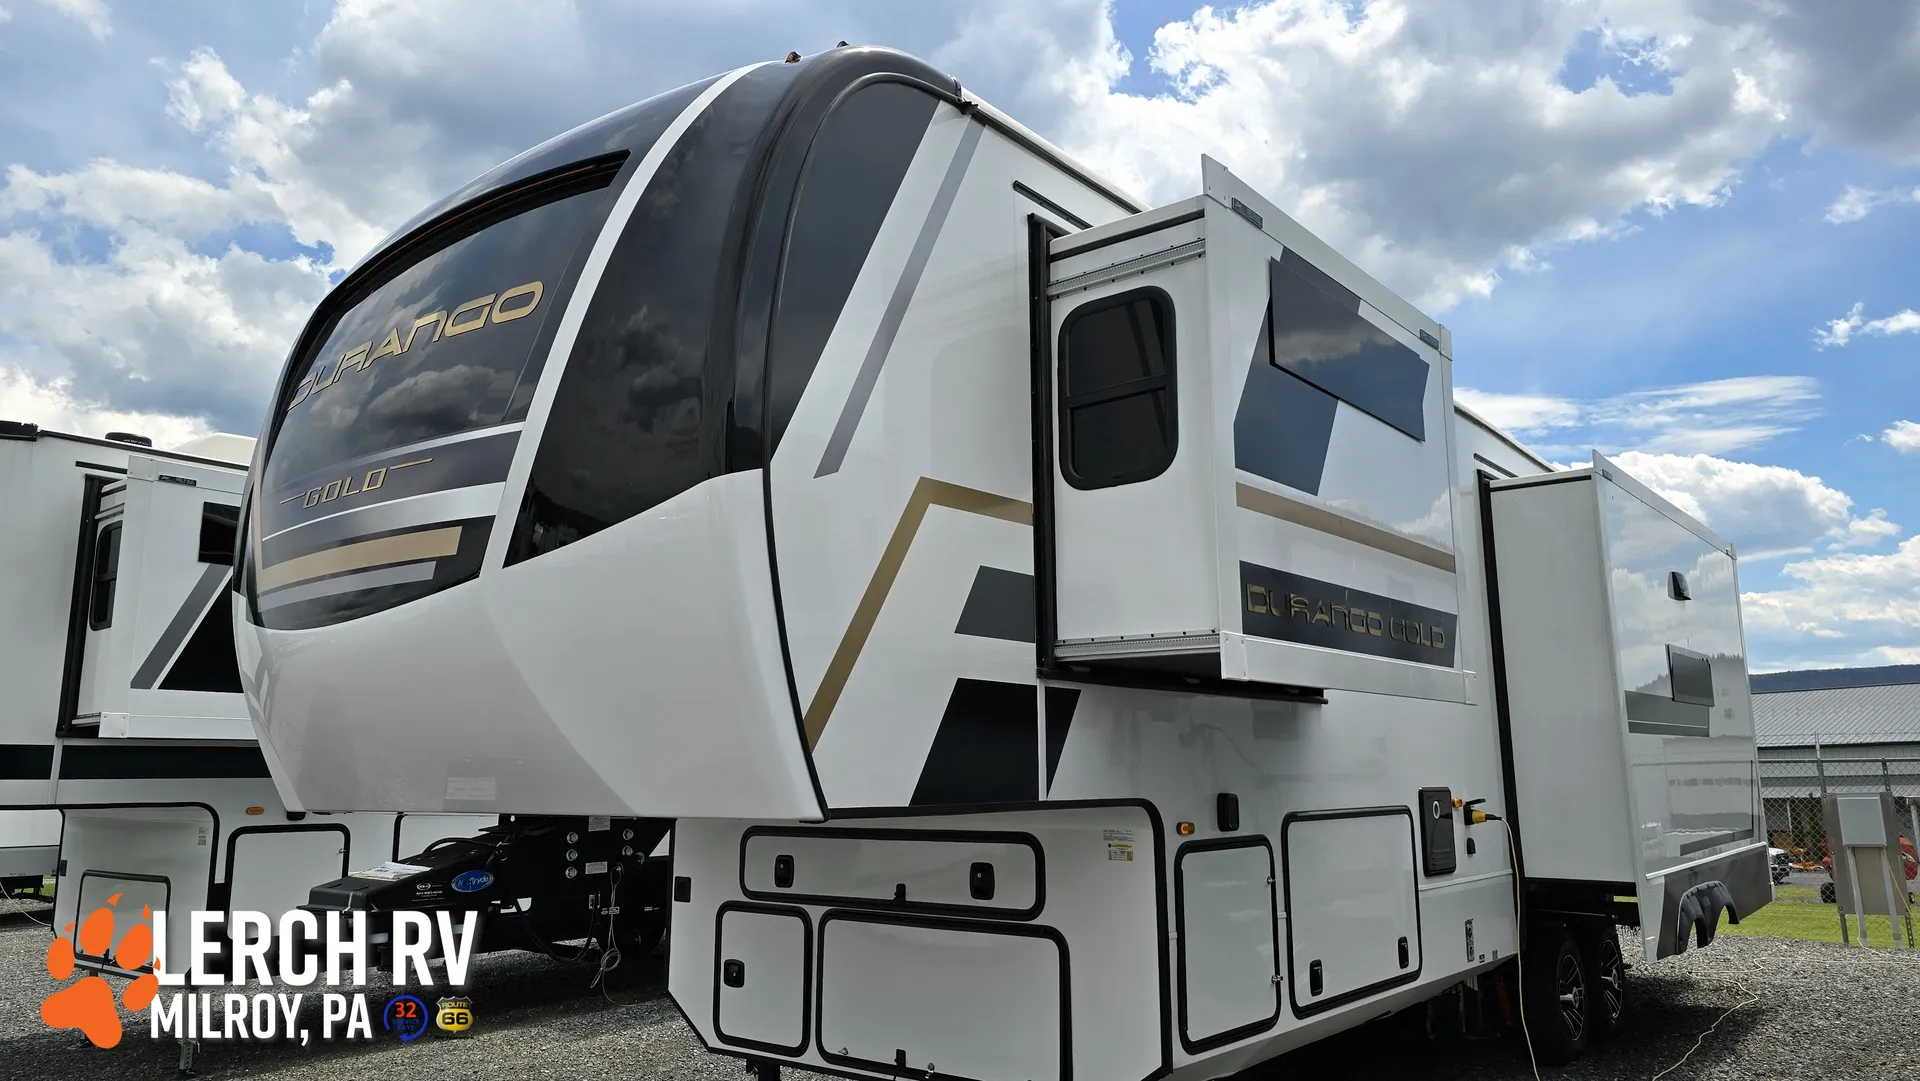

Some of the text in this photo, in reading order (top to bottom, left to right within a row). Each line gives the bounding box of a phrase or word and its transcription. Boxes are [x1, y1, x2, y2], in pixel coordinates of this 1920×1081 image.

[287, 281, 543, 411] DURANGO
[303, 467, 388, 509] GOLD
[1246, 584, 1445, 649] DURANGO GOLD
